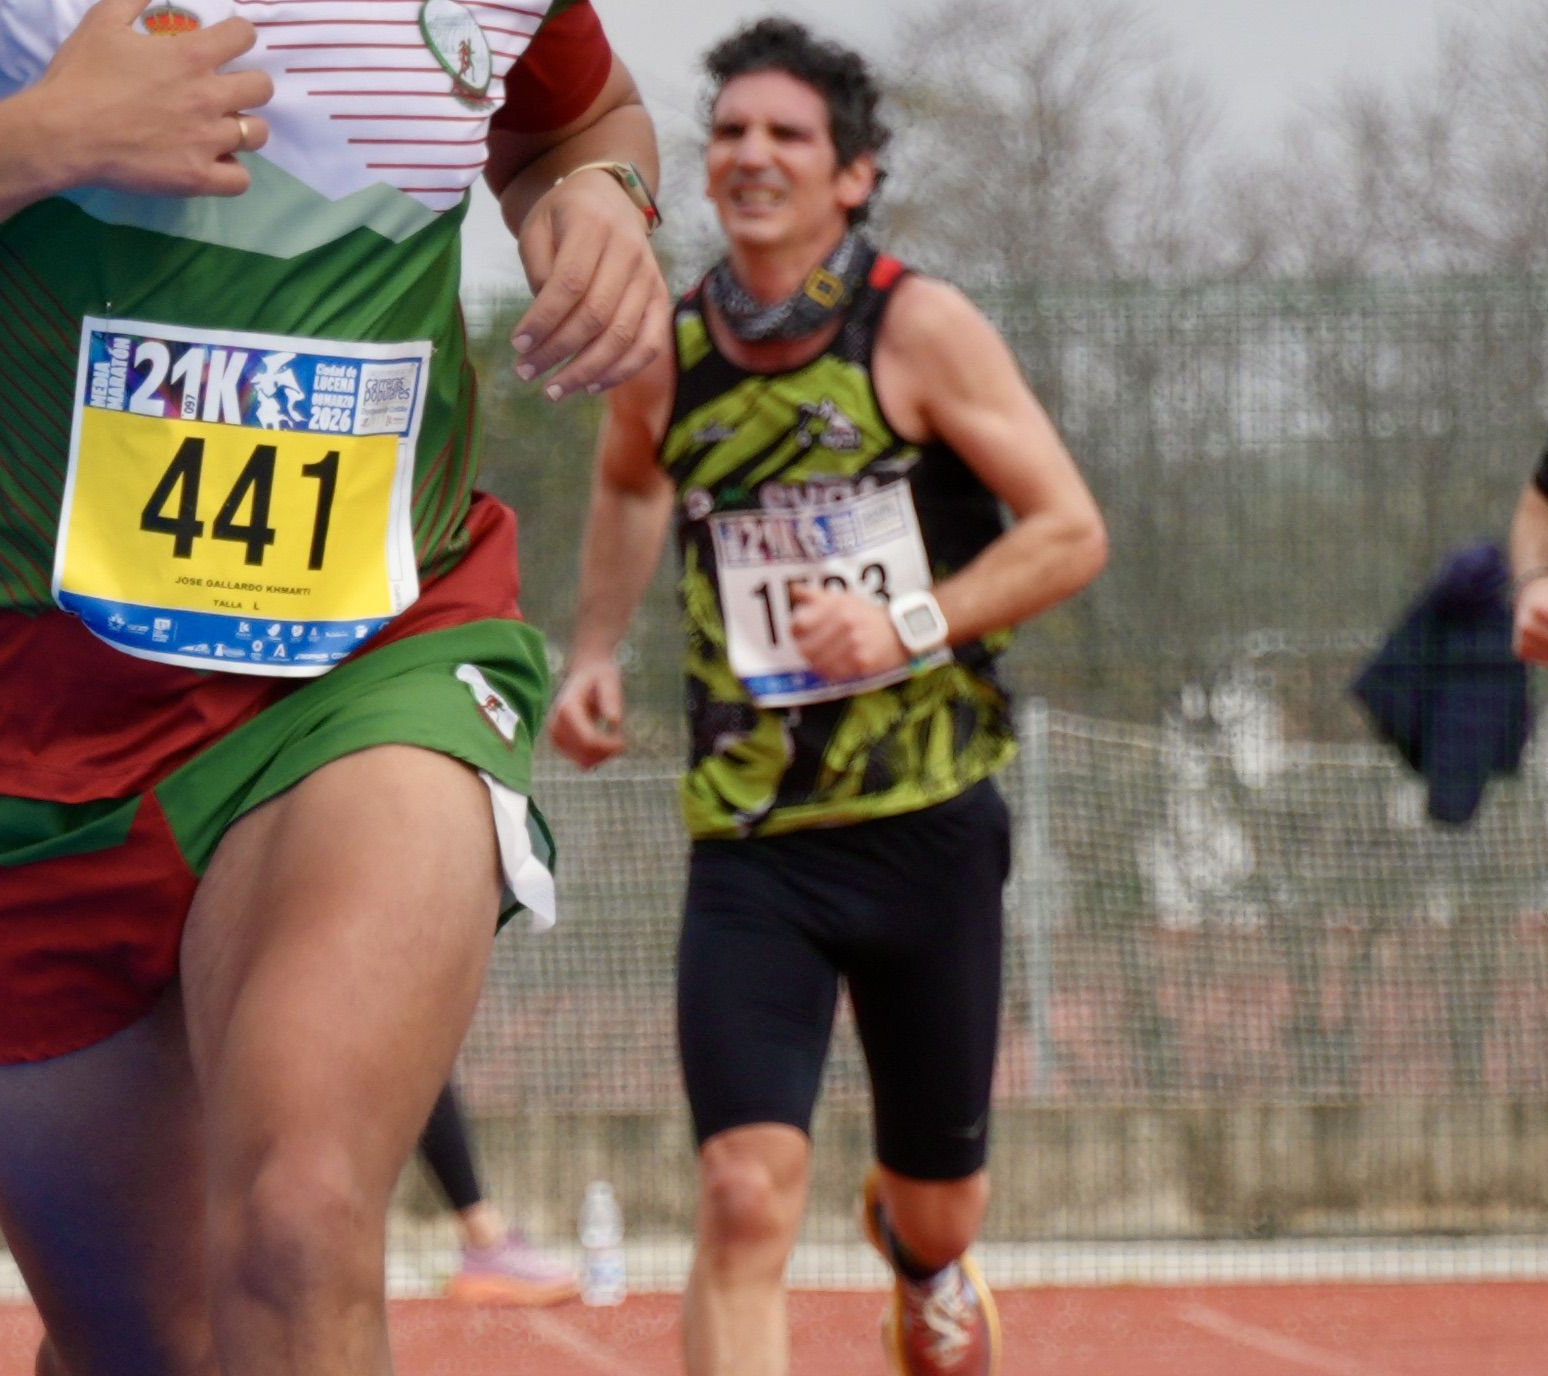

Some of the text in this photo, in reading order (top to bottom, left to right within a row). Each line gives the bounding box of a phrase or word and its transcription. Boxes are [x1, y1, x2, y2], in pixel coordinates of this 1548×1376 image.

[129, 341, 249, 425] 21K
[308, 405, 352, 433] 2026
[139, 436, 340, 571] 441
[175, 576, 203, 587] JOSE
[206, 579, 263, 593] GALLARDO
[213, 599, 243, 609] TALLA
